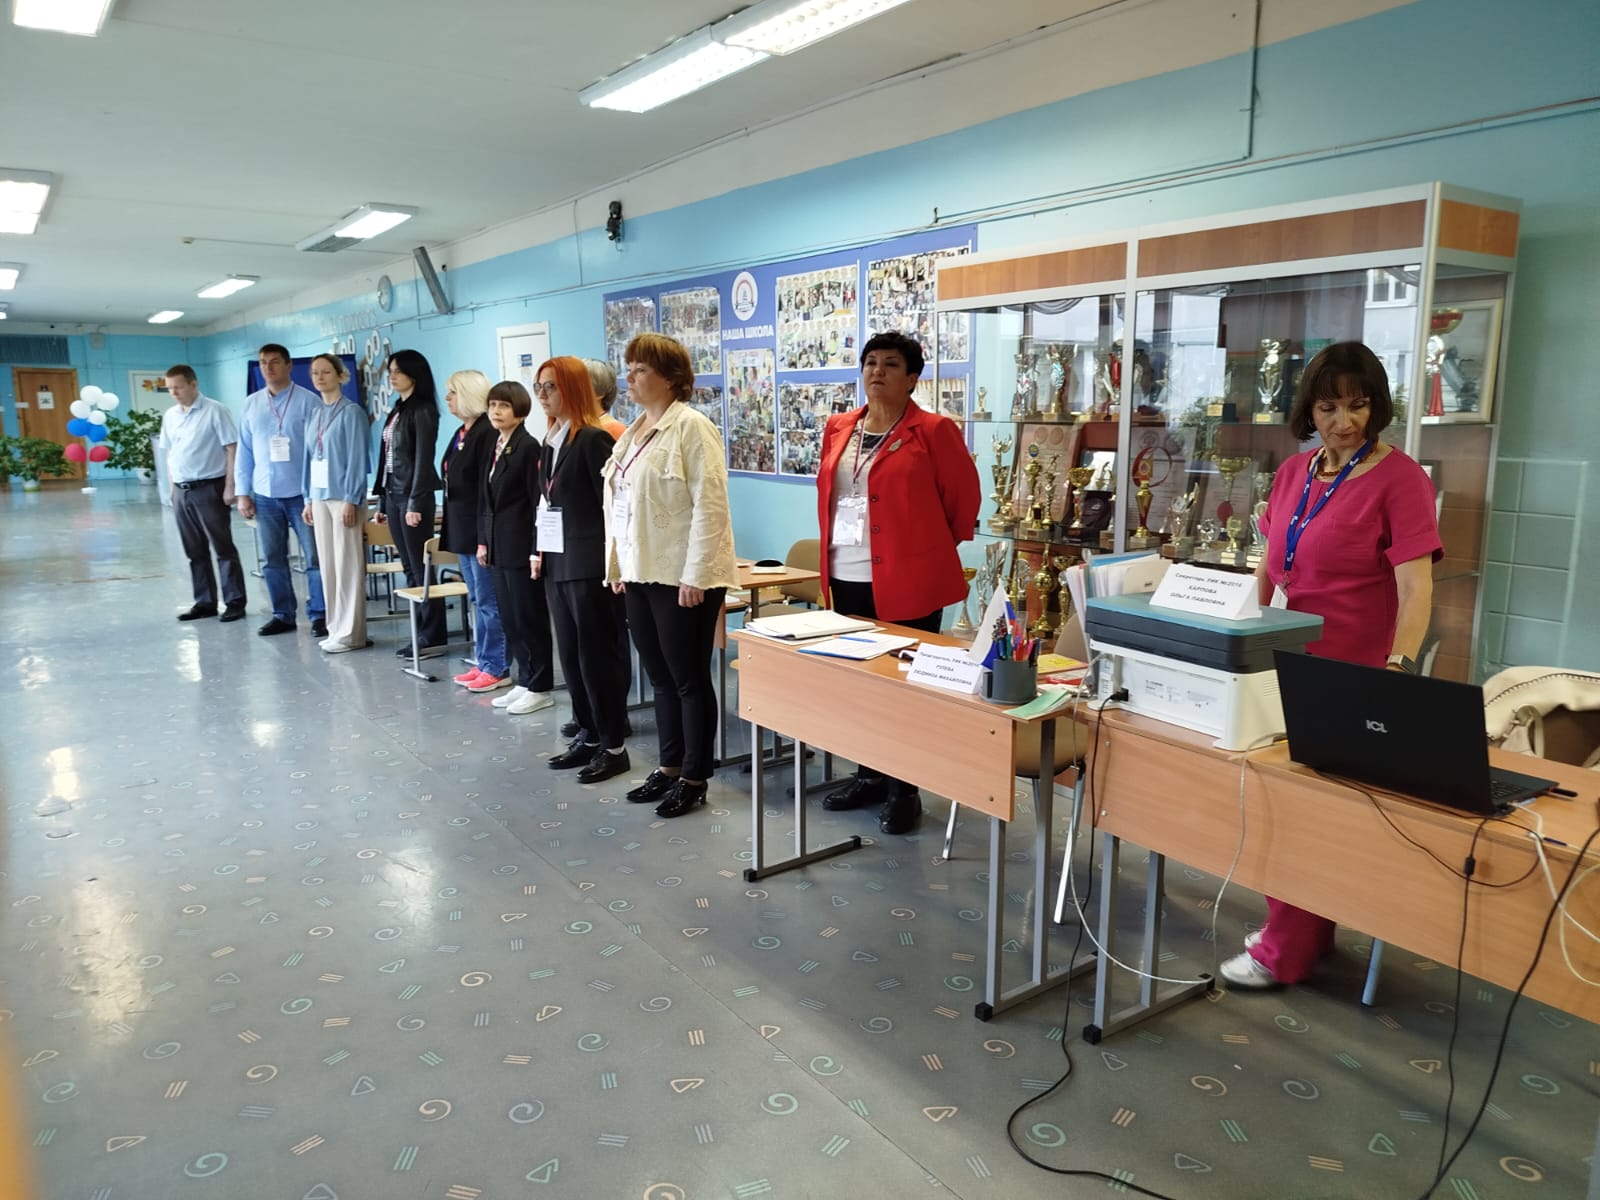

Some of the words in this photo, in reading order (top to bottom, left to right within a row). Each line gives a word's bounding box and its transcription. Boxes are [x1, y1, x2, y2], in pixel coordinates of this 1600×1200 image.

[722, 328, 745, 340] НАША
[745, 325, 774, 339] ШКОЛА
[1366, 719, 1388, 733] ICL
